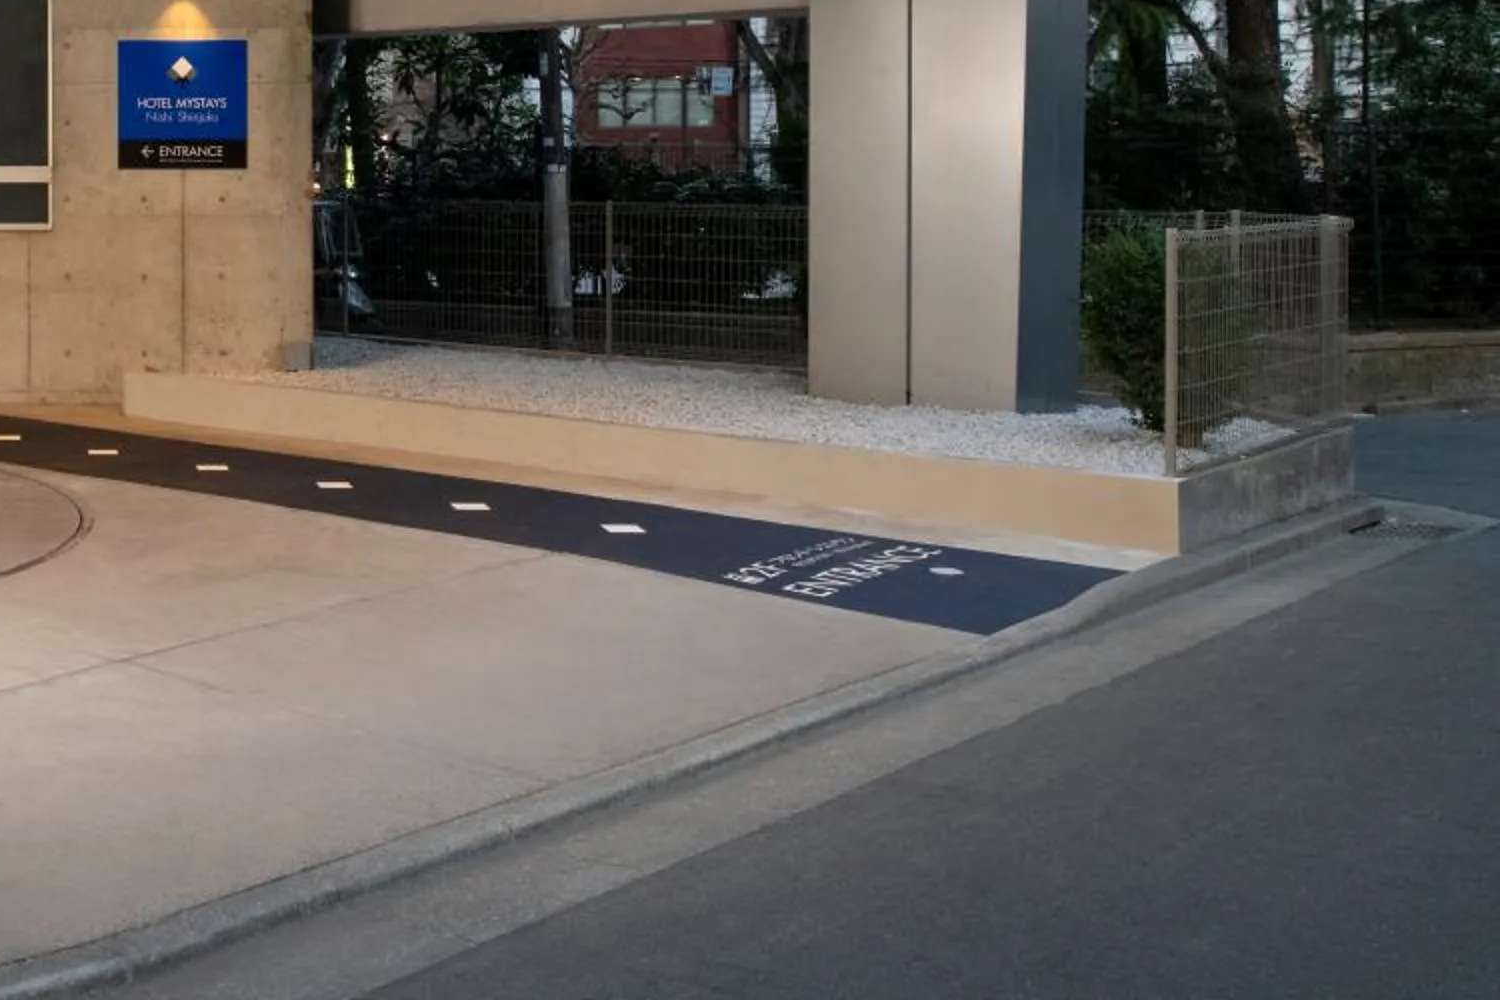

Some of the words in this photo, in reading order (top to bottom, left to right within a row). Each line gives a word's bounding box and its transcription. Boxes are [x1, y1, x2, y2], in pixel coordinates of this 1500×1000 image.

[137, 97, 173, 109] HOTEL
[175, 97, 227, 109] MYSTAYS
[159, 145, 224, 157] ENTRANCE
[781, 545, 943, 598] ENTRANCE
